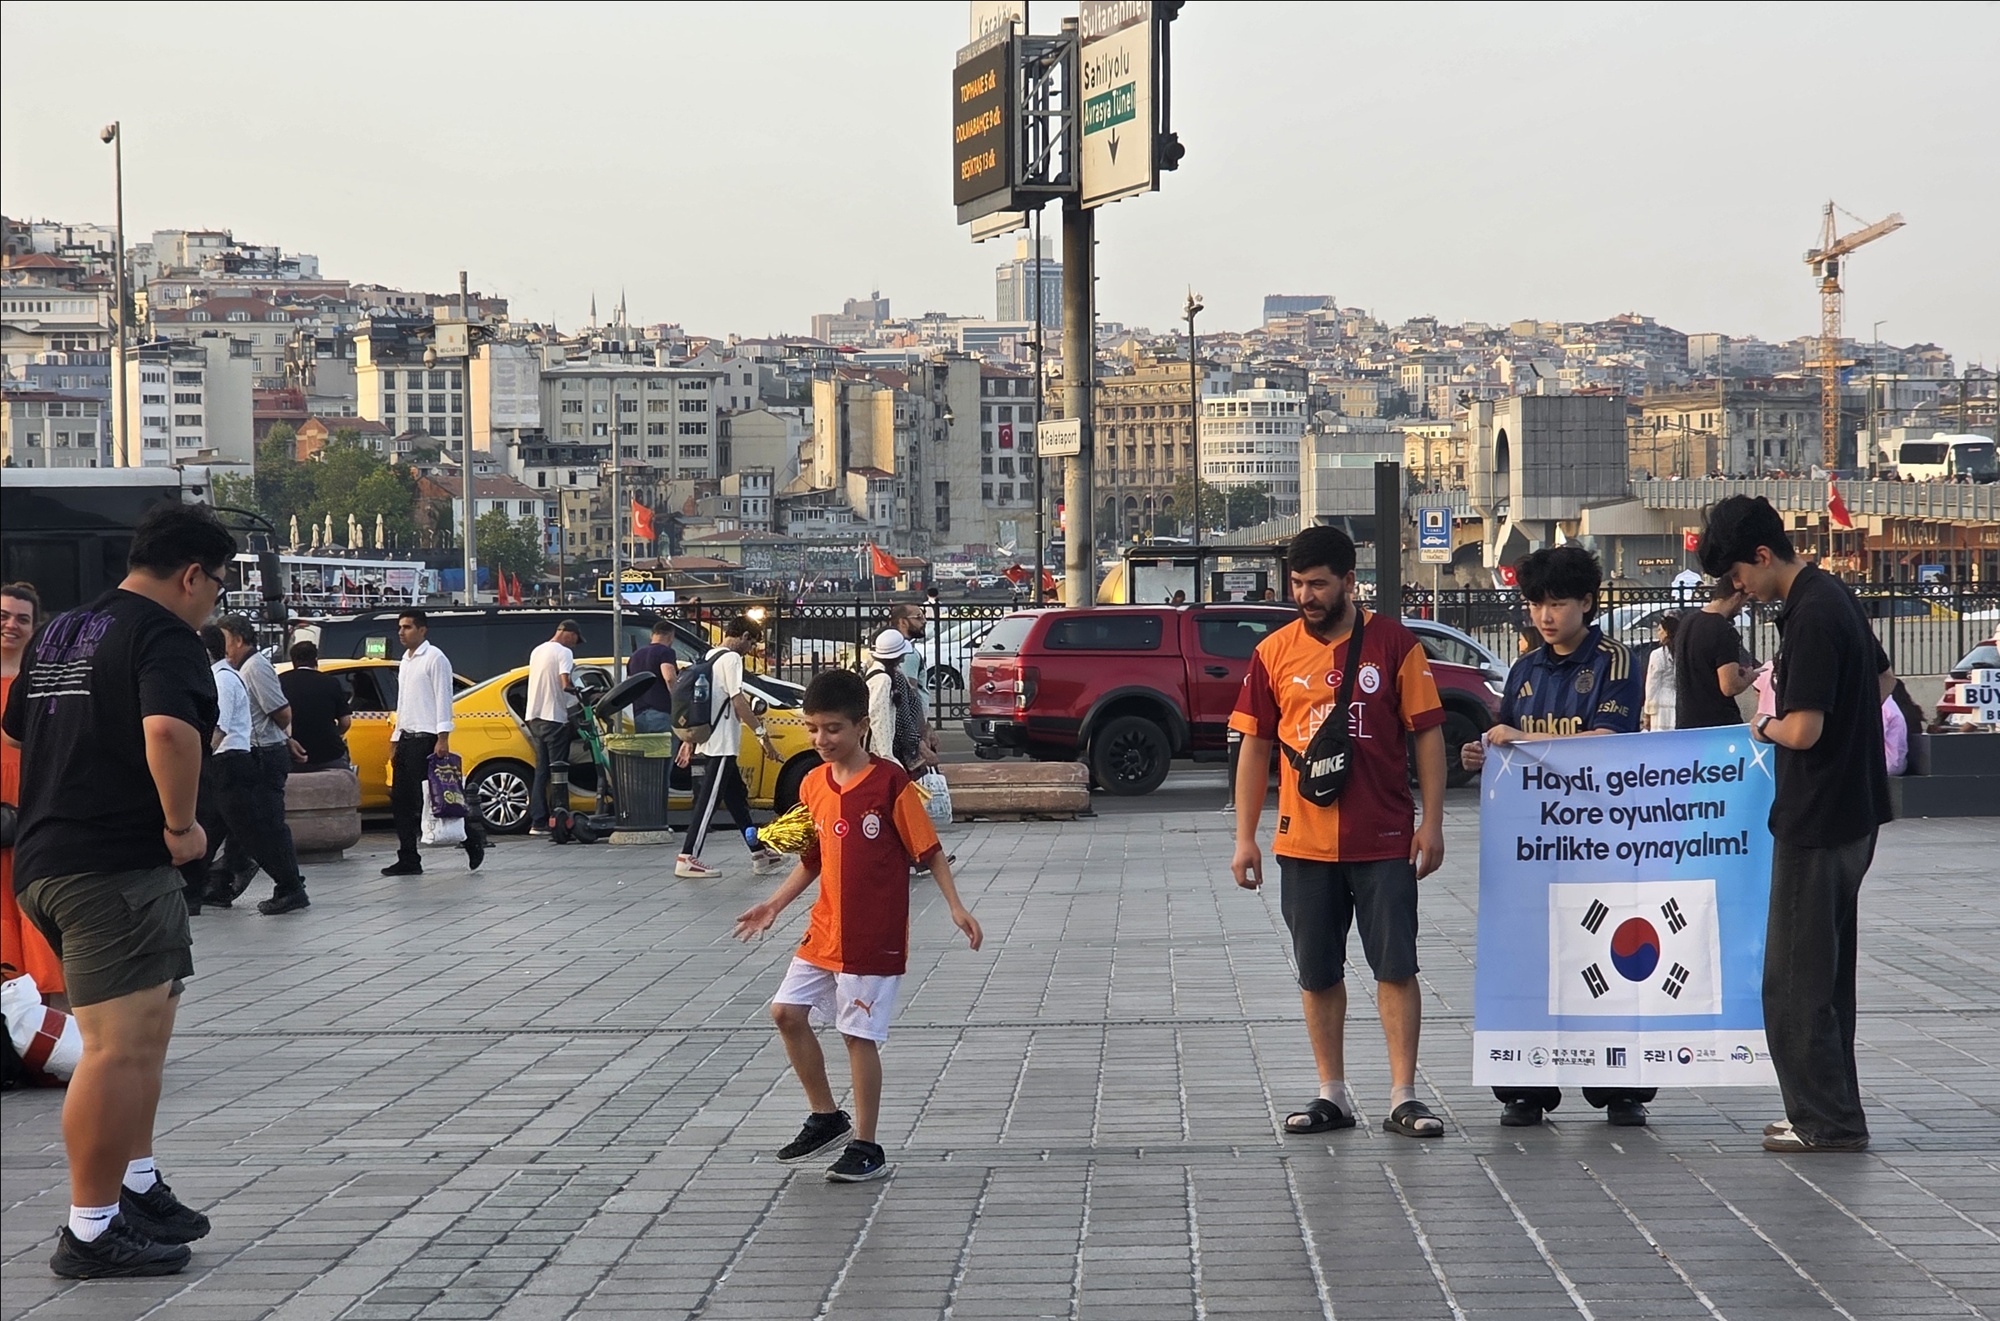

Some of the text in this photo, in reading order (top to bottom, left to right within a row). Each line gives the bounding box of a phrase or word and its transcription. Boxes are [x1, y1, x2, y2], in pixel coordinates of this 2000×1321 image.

[1084, 46, 1130, 90] Sahilyolu
[1085, 83, 1136, 127] Avrasya Tüneli
[1045, 429, 1077, 449] Galataport
[1296, 718, 1373, 742] LEEL
[1310, 752, 1345, 779] NIKE
[1522, 757, 1745, 796] Haydi, geleneksel
[1541, 798, 1725, 831] Kore oyunlarını
[1516, 830, 1749, 867] birlikte oynayalım!
[1490, 1049, 1514, 1061] 주최
[1644, 1050, 1666, 1063] 주관
[1731, 1052, 1749, 1061] NRF
